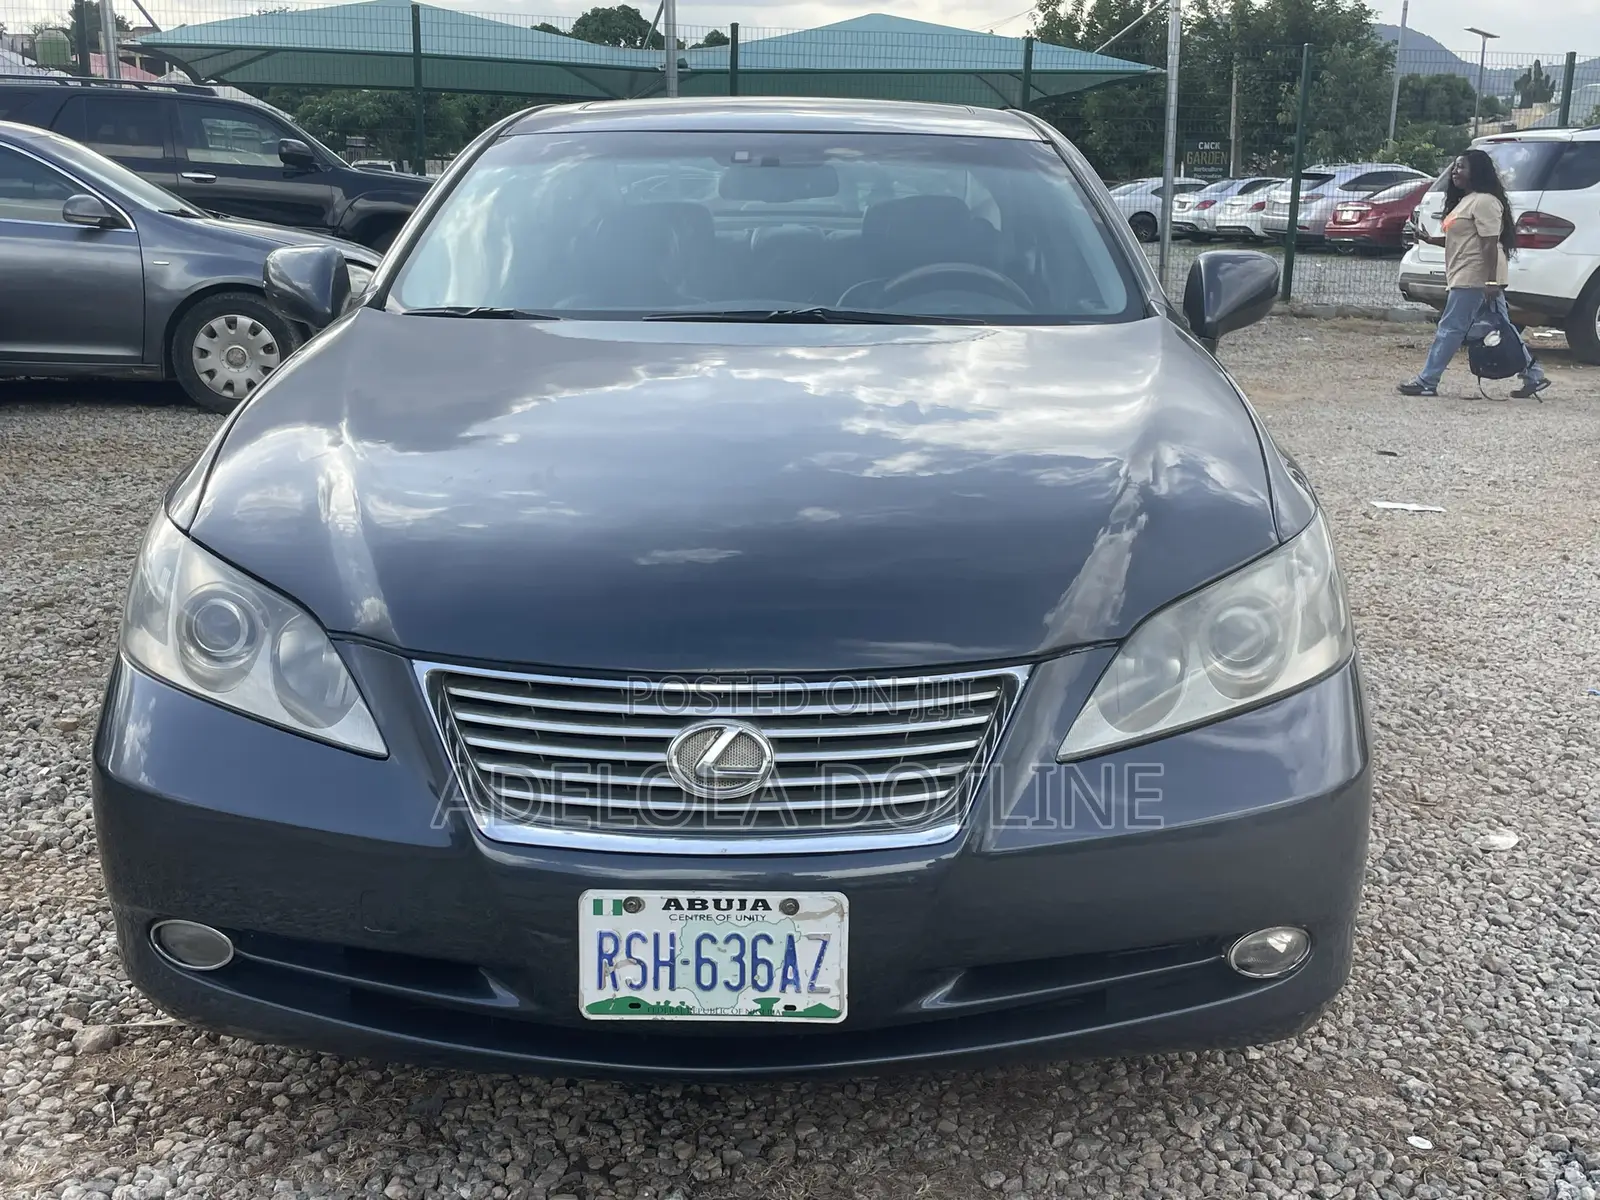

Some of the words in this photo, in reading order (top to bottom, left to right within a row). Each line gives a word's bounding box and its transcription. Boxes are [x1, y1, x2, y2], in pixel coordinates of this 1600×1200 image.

[1186, 151, 1228, 165] GARDEN
[661, 898, 773, 911] ABUJA
[668, 913, 713, 922] CENTRE
[715, 913, 732, 922] OF
[735, 913, 767, 922] UNITY
[595, 929, 832, 993] RSH-636AZ
[730, 1007, 742, 1015] OF
